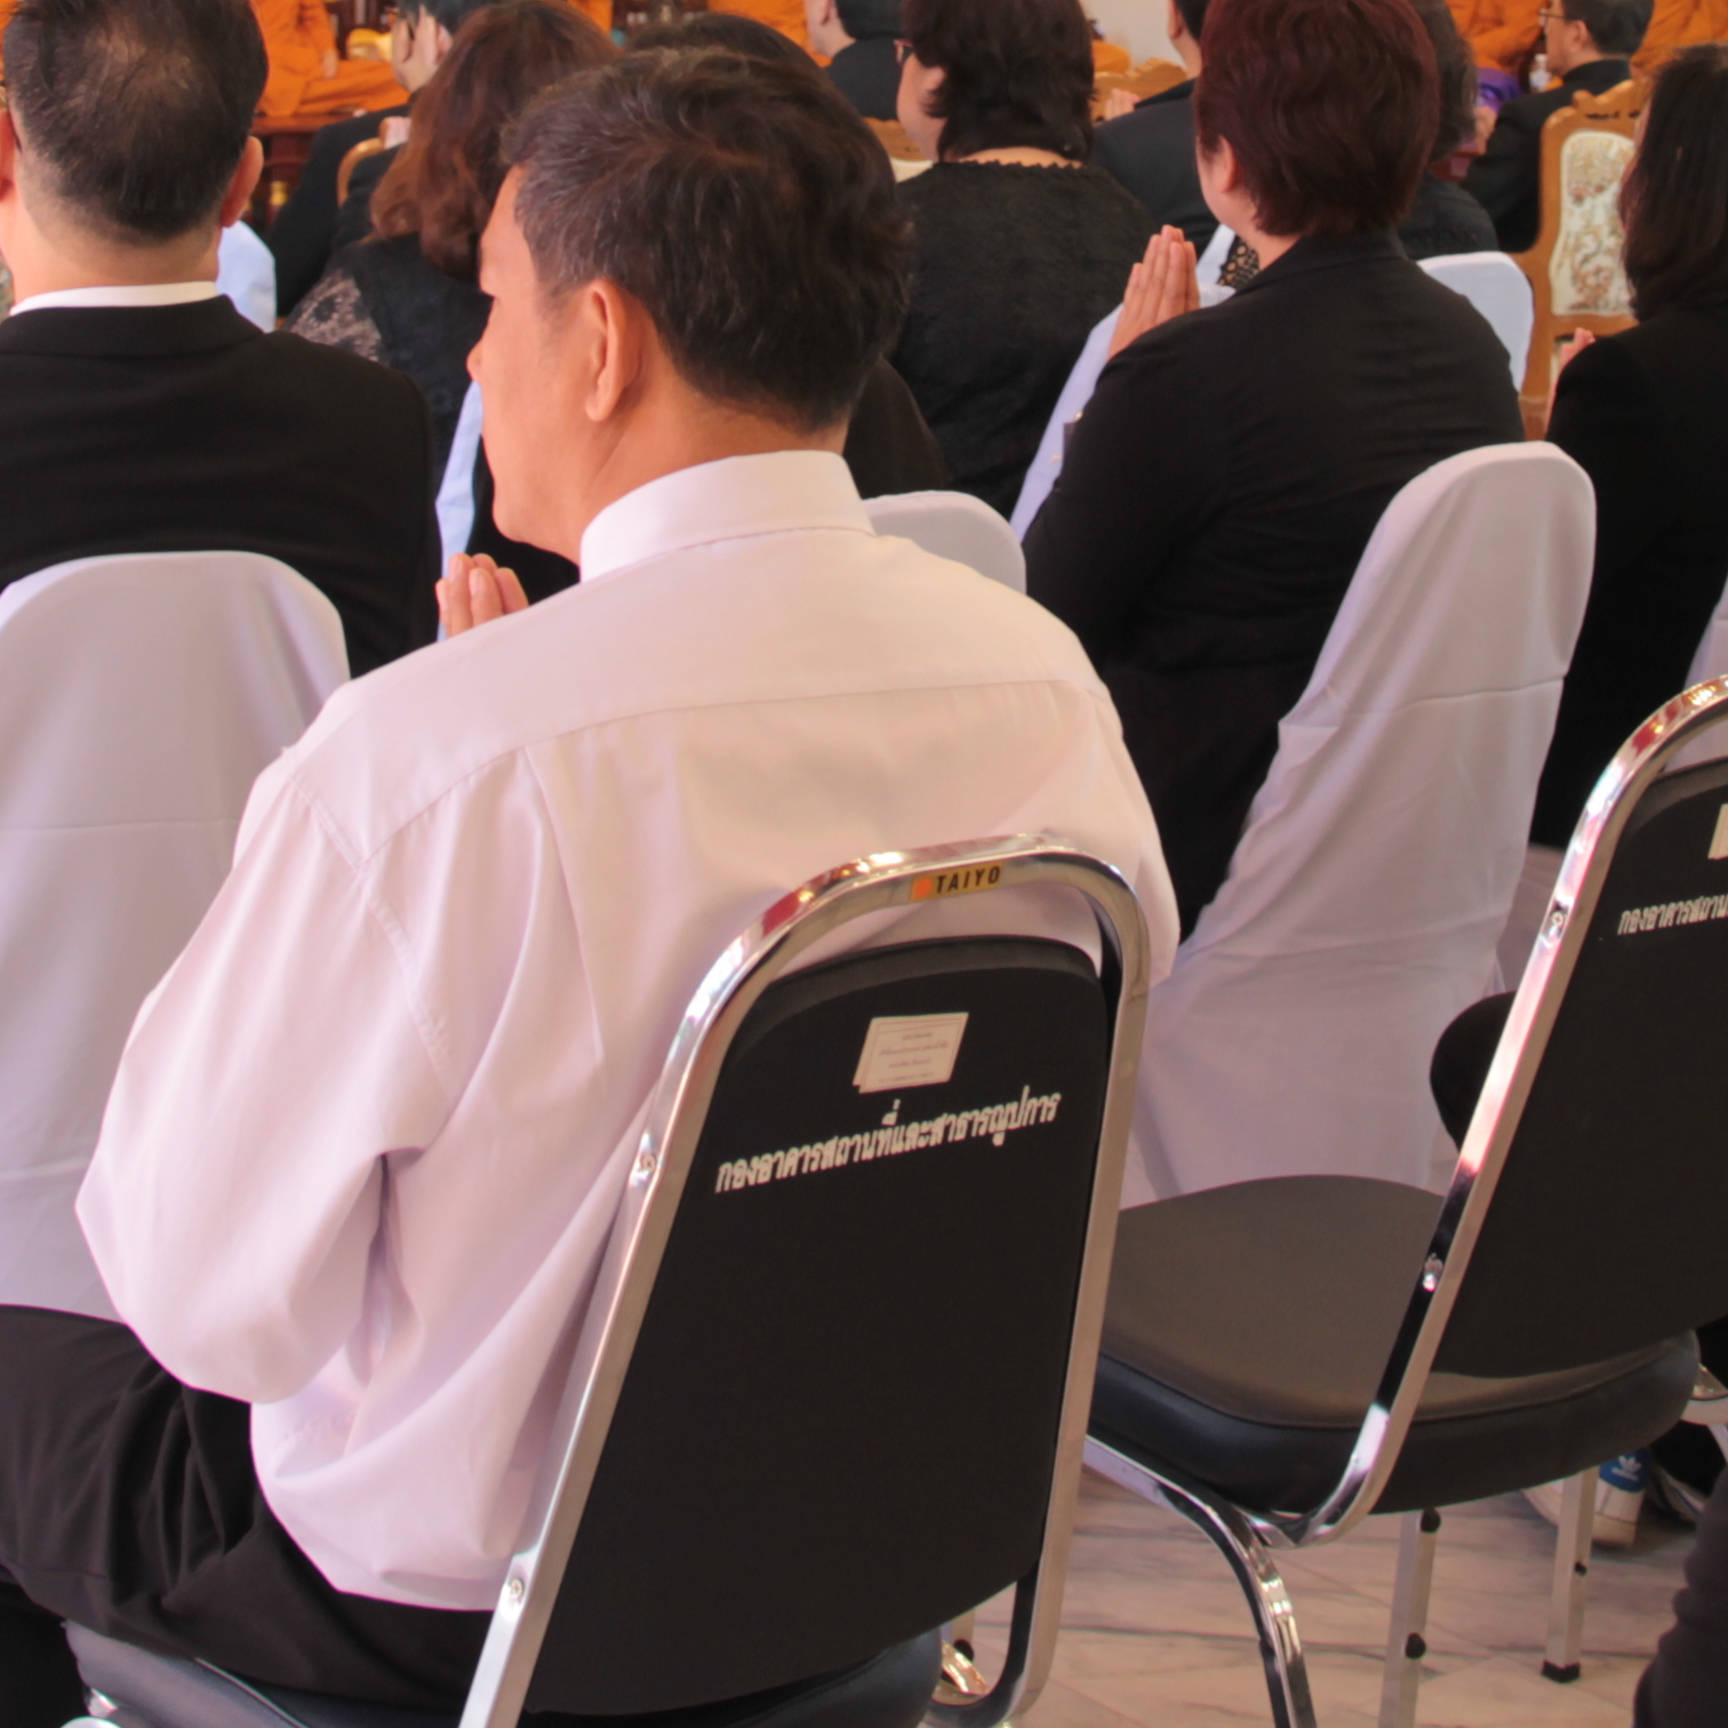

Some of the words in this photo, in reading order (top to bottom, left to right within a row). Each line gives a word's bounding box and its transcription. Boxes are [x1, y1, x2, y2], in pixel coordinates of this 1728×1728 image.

[936, 865, 1000, 893] TAIYO
[714, 1084, 1063, 1194] กองอาคารสถานที่และสาธารณูปการ
